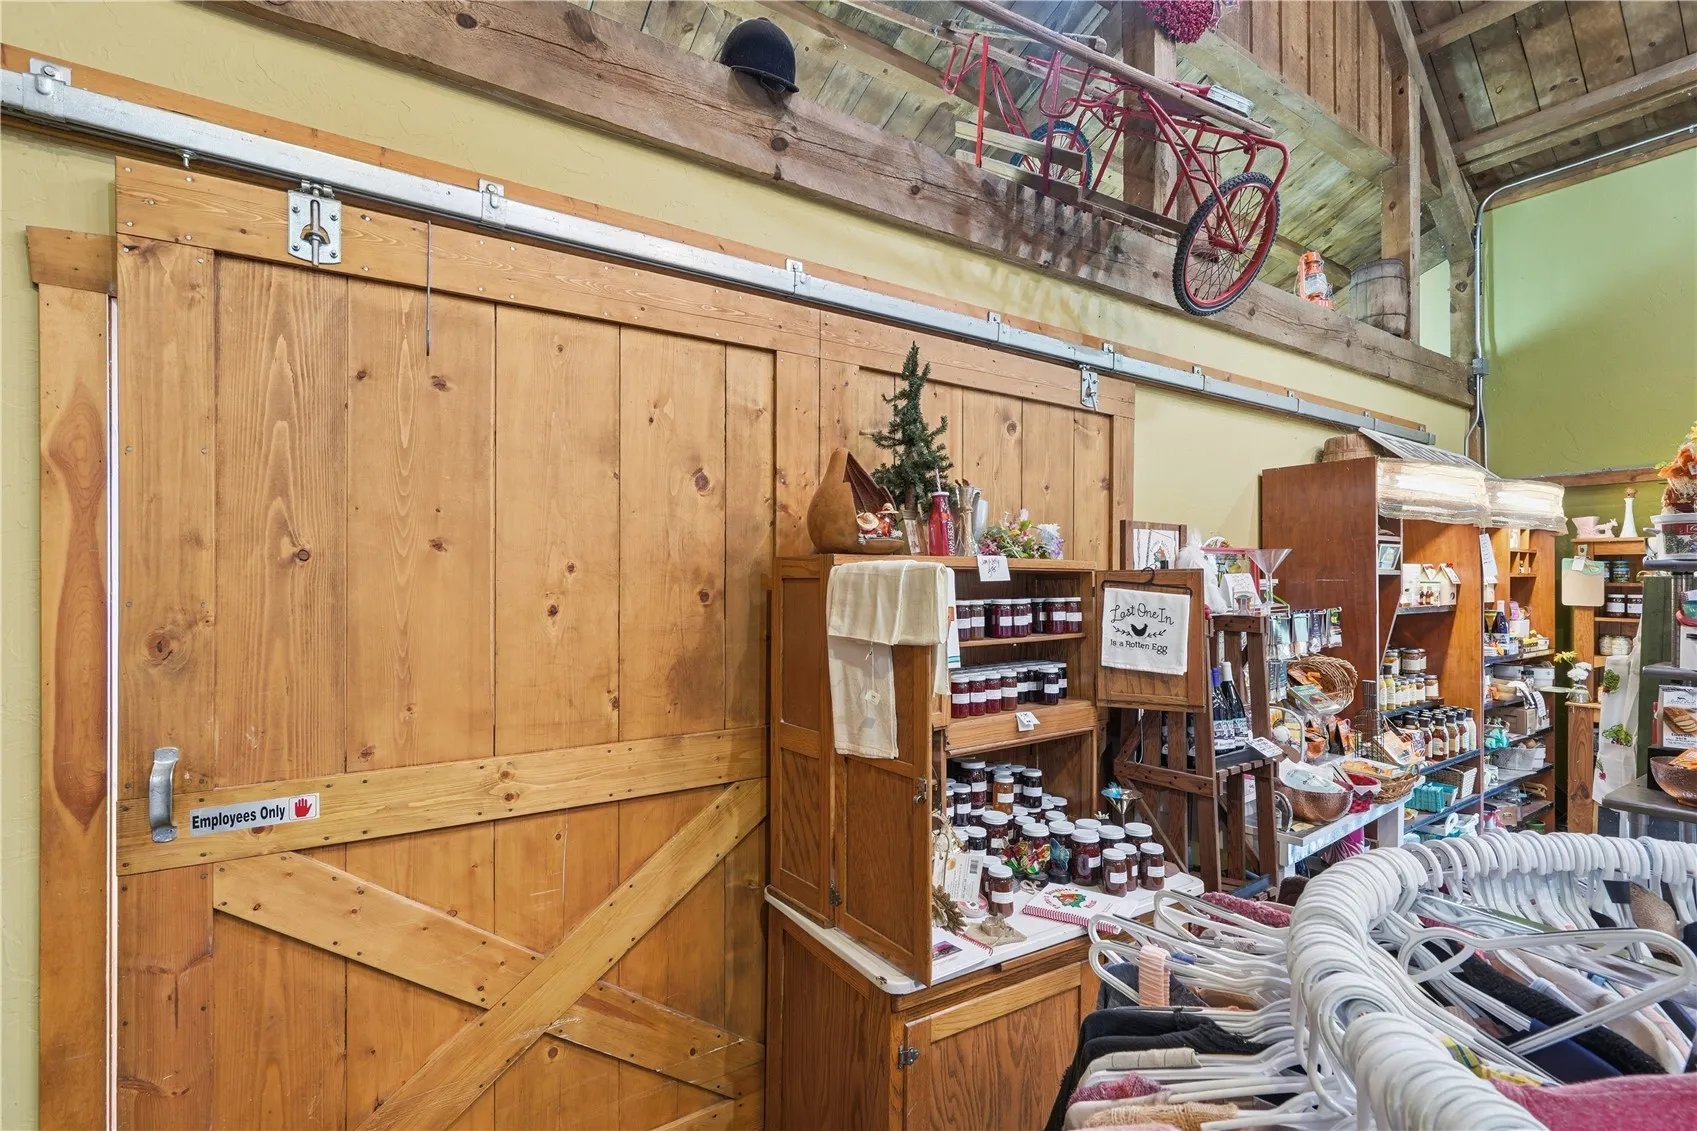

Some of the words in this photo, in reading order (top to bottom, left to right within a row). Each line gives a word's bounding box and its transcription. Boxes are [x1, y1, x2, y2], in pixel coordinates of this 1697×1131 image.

[947, 521, 955, 539] FRESH
[1109, 604, 1135, 624] Last
[1137, 602, 1159, 619] One
[1158, 607, 1175, 626] In
[1125, 640, 1150, 650] Rotten
[1152, 643, 1168, 655] Egg
[192, 810, 257, 830] Employees
[260, 805, 286, 821] Only
